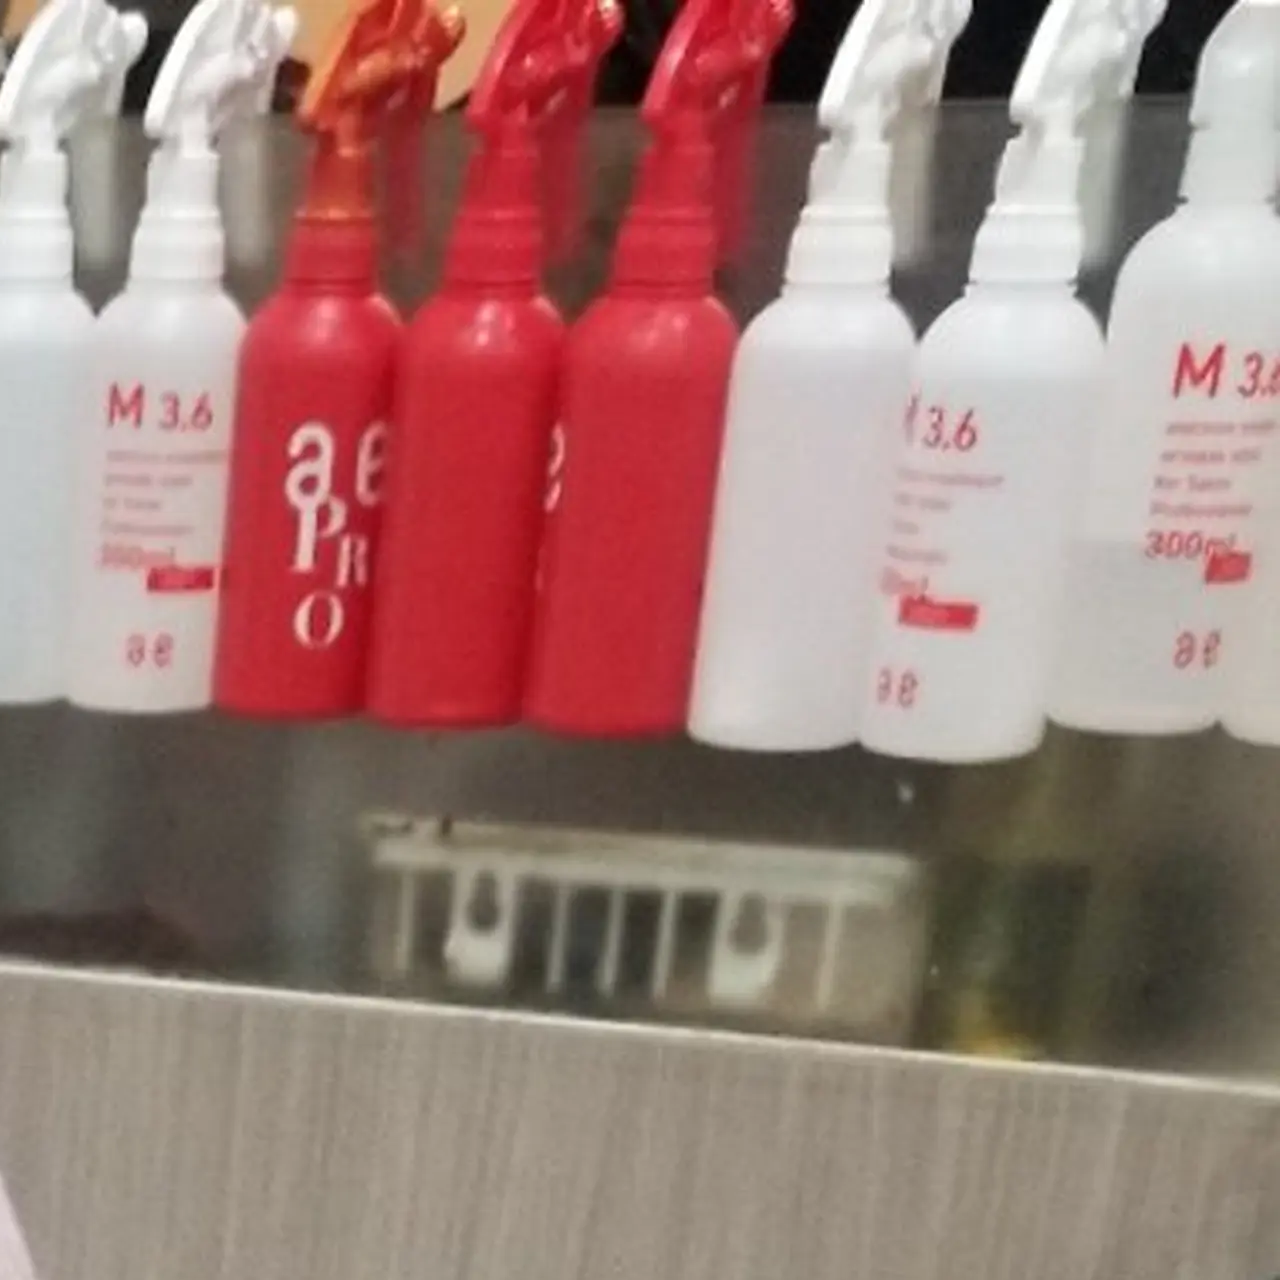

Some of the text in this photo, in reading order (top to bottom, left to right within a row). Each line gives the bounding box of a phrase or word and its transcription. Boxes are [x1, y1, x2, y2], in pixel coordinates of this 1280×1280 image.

[1173, 342, 1225, 399] M
[107, 381, 213, 433] M 3.6
[922, 404, 978, 453] 3.6
